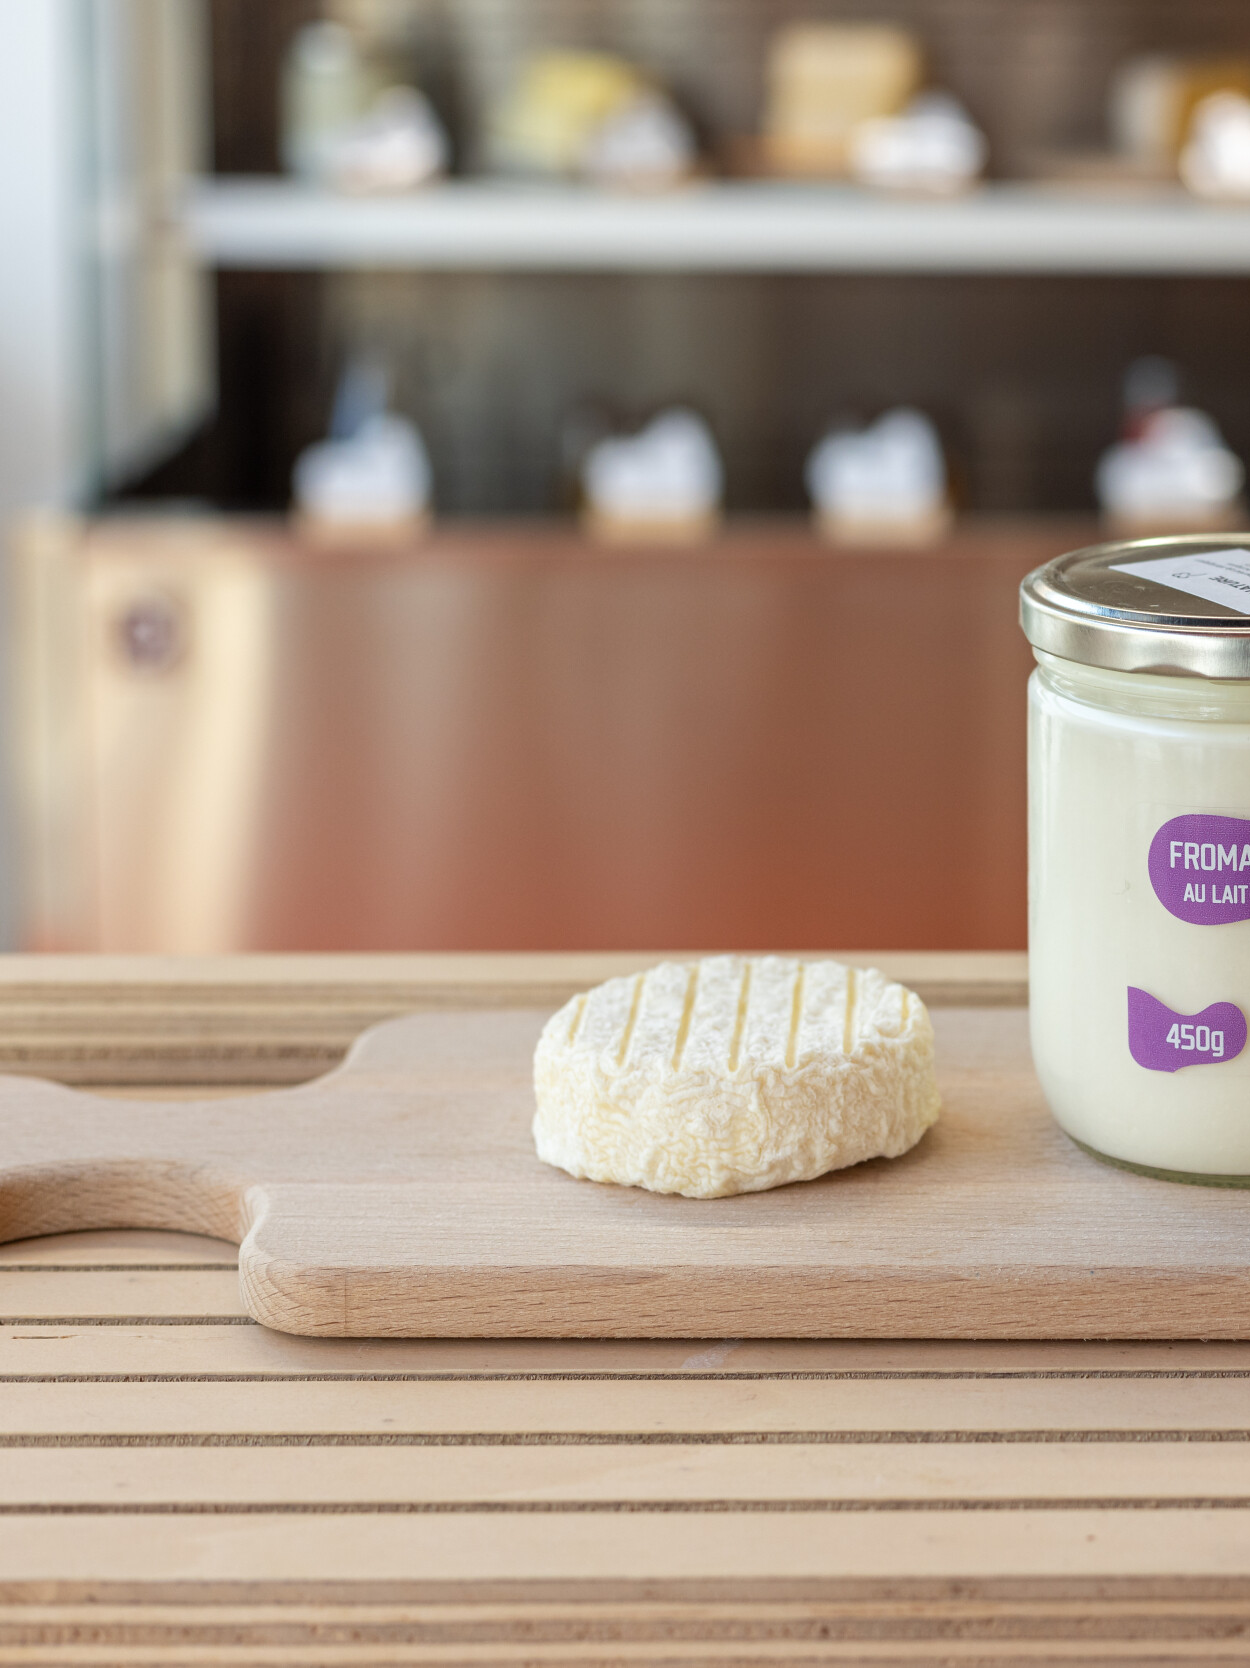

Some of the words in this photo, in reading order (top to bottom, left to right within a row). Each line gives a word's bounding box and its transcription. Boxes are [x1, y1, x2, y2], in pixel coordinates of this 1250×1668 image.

[1183, 883, 1206, 903] AU
[1212, 884, 1249, 904] LAIT
[1166, 1023, 1224, 1057] 450g
